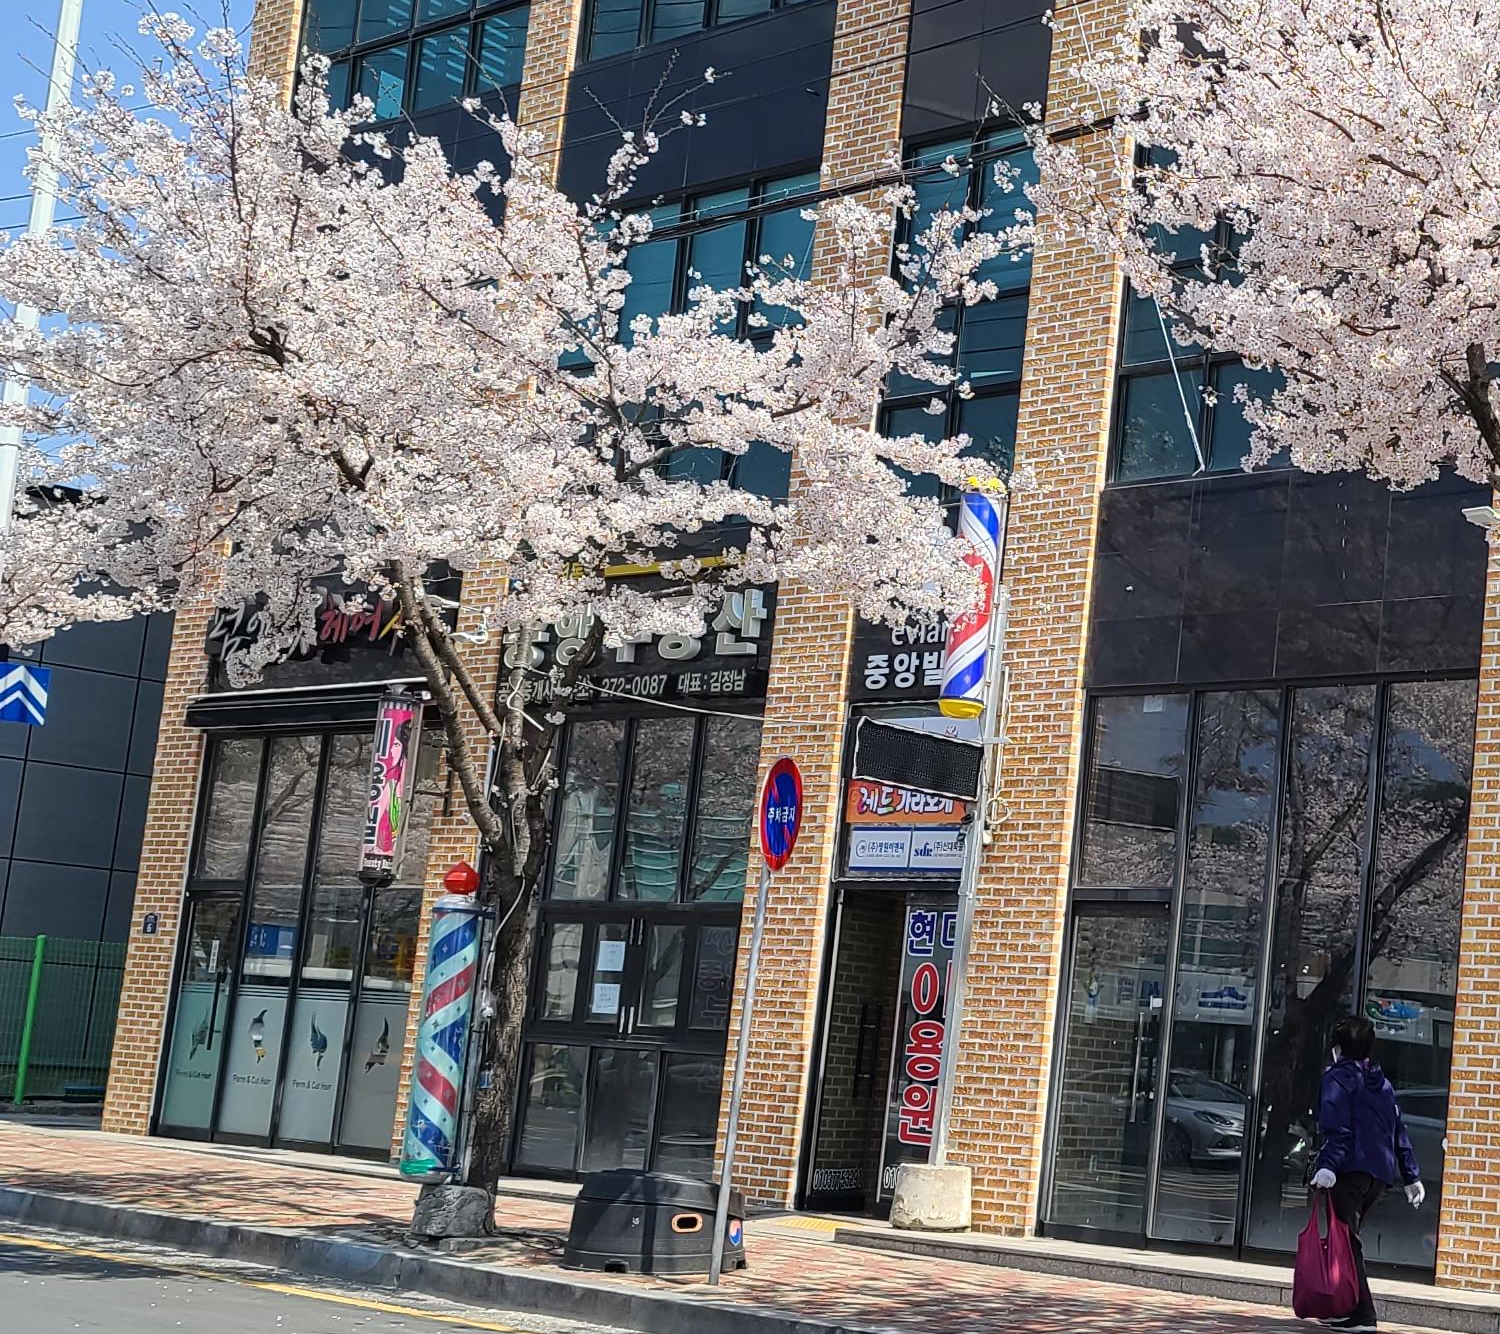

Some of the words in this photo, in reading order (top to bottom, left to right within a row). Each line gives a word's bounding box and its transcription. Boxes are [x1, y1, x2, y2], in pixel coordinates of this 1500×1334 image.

[864, 650, 945, 690] 중앙빌
[601, 674, 667, 696] 272-0087
[896, 788, 954, 815] 가라오케
[768, 806, 796, 824] 주차금지
